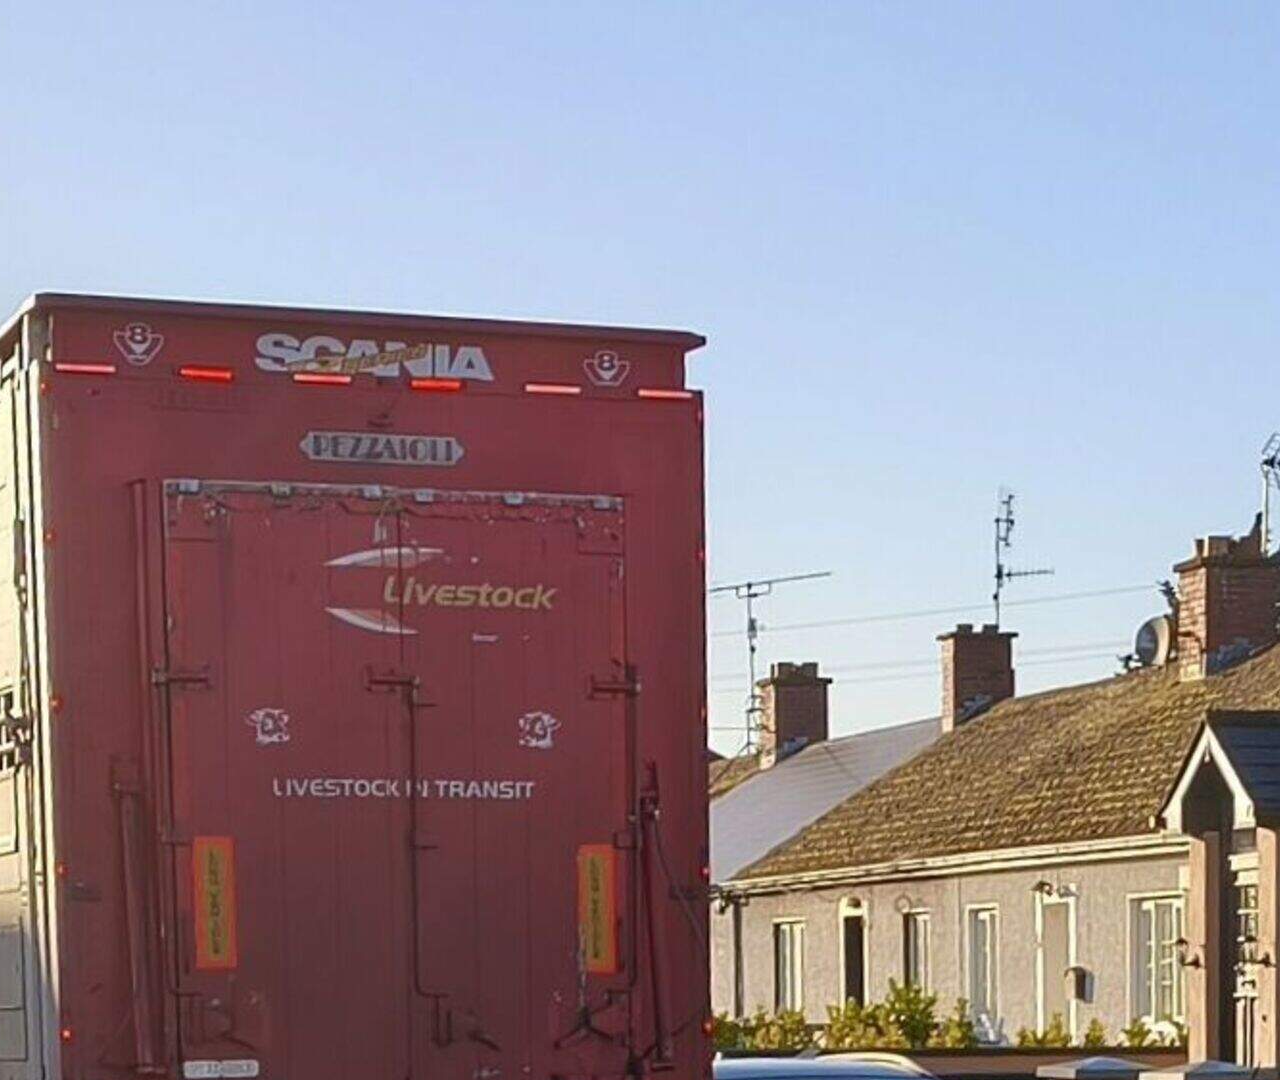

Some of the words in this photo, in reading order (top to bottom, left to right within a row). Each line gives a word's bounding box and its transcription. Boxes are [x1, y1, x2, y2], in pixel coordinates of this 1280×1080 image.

[255, 333, 494, 381] SCANIA
[383, 575, 558, 610] Livestock
[272, 778, 400, 797] LIVESTOCK
[404, 780, 429, 798] IN
[435, 780, 535, 799] TRANSIT
